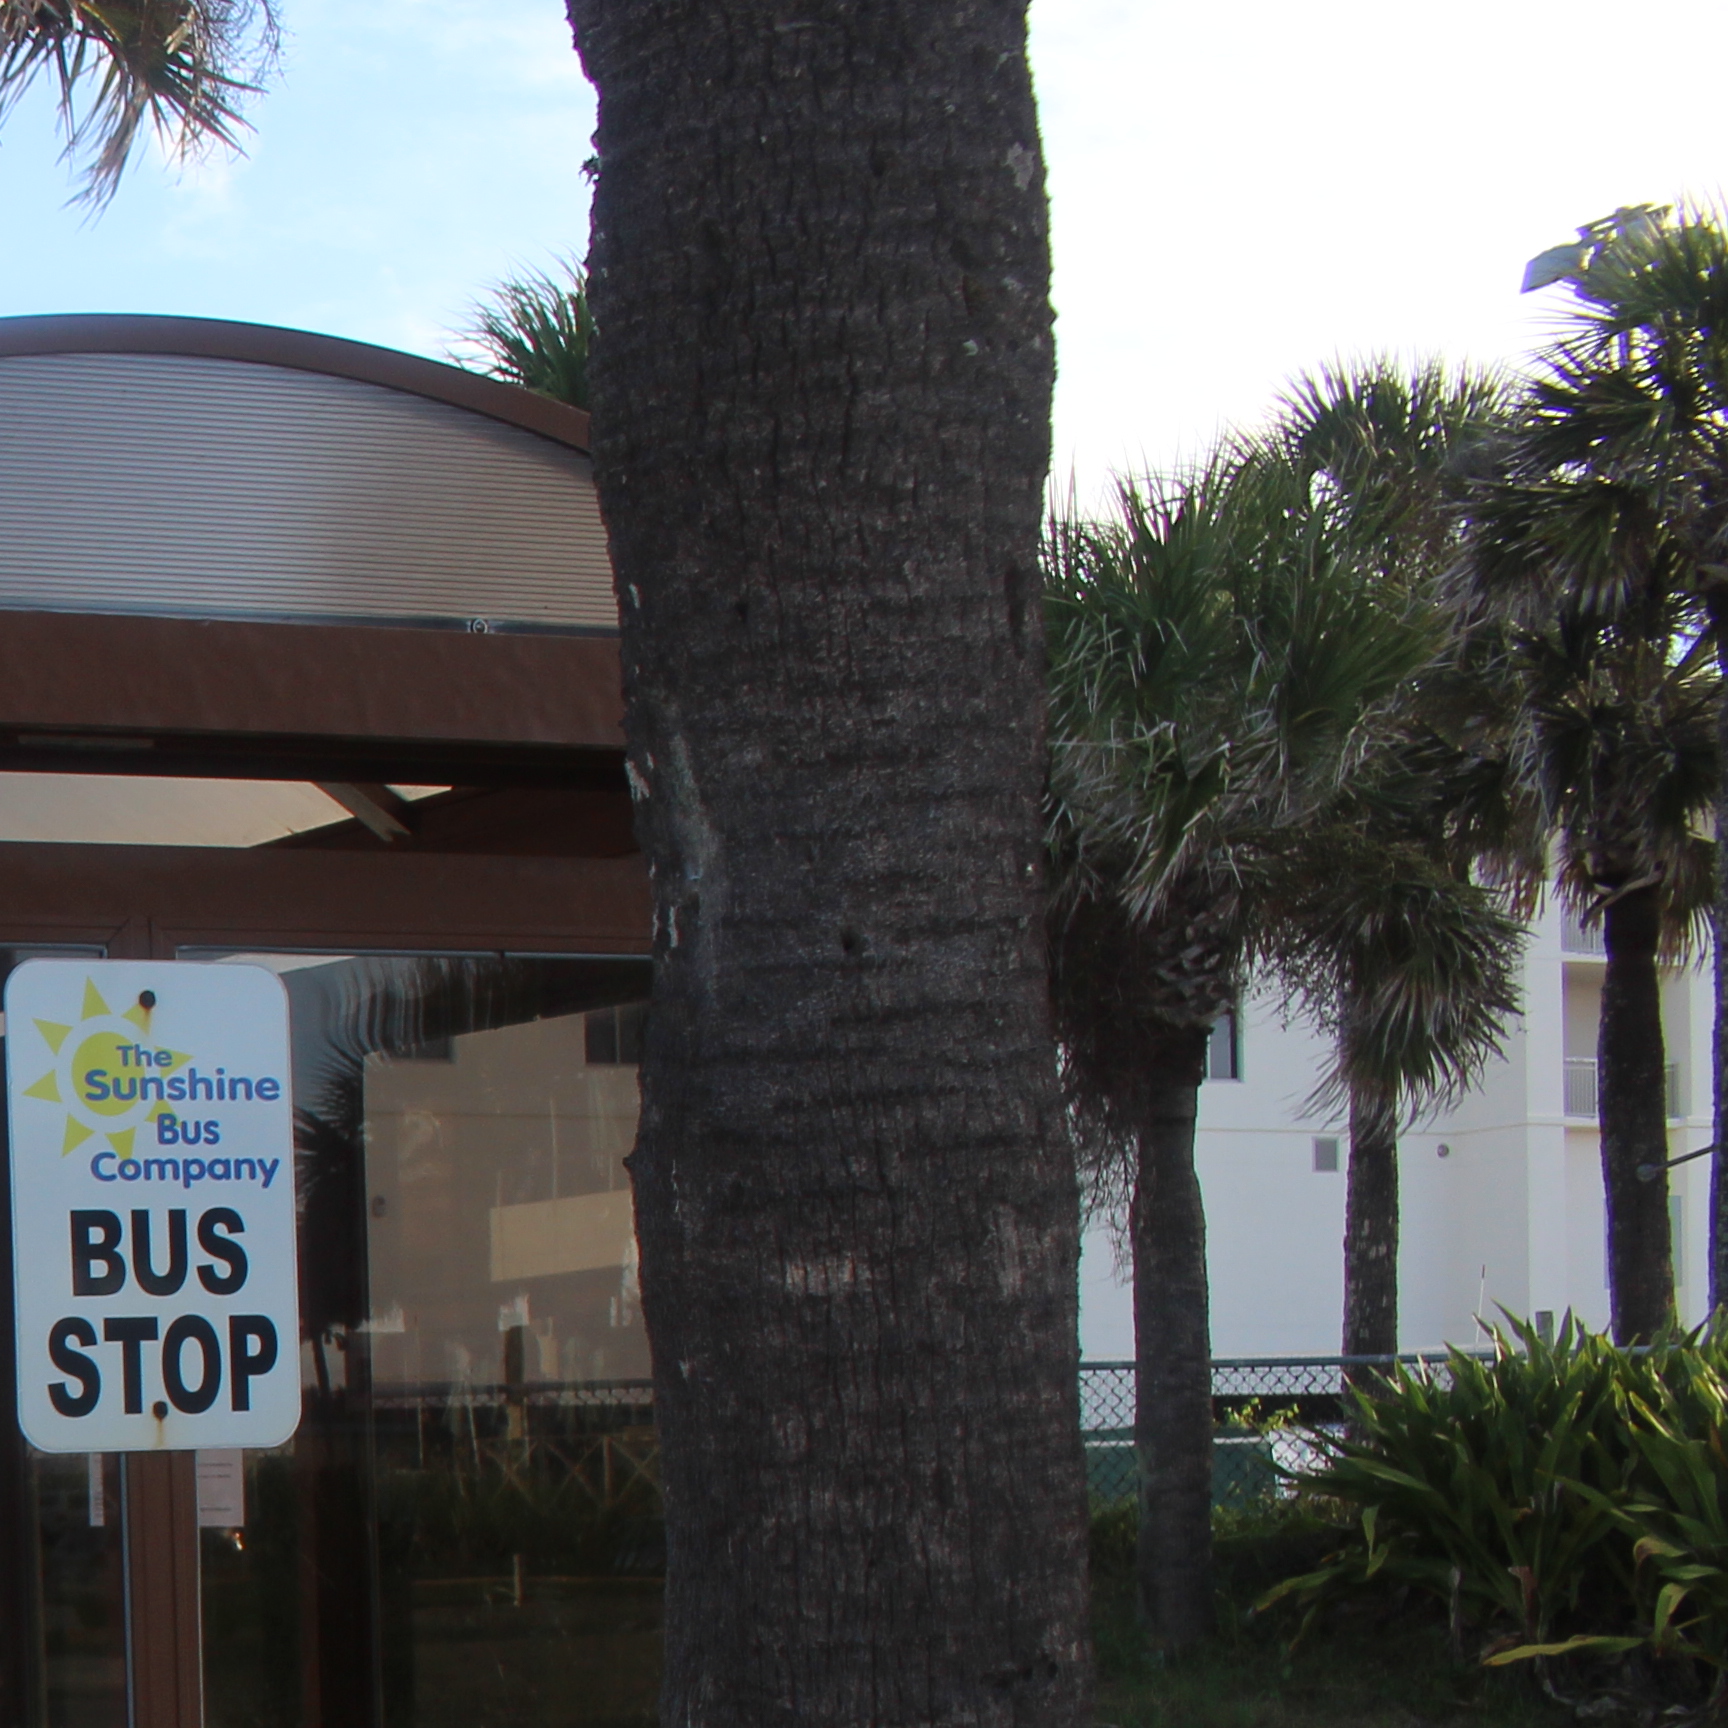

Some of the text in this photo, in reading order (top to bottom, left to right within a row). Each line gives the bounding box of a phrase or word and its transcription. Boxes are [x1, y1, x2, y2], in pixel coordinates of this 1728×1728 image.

[116, 1045, 173, 1067] The
[85, 1068, 281, 1101] Sunshine
[157, 1113, 220, 1144] Bus
[91, 1152, 280, 1188] Company
[70, 1207, 249, 1296] BUS
[48, 1314, 278, 1417] STOP
